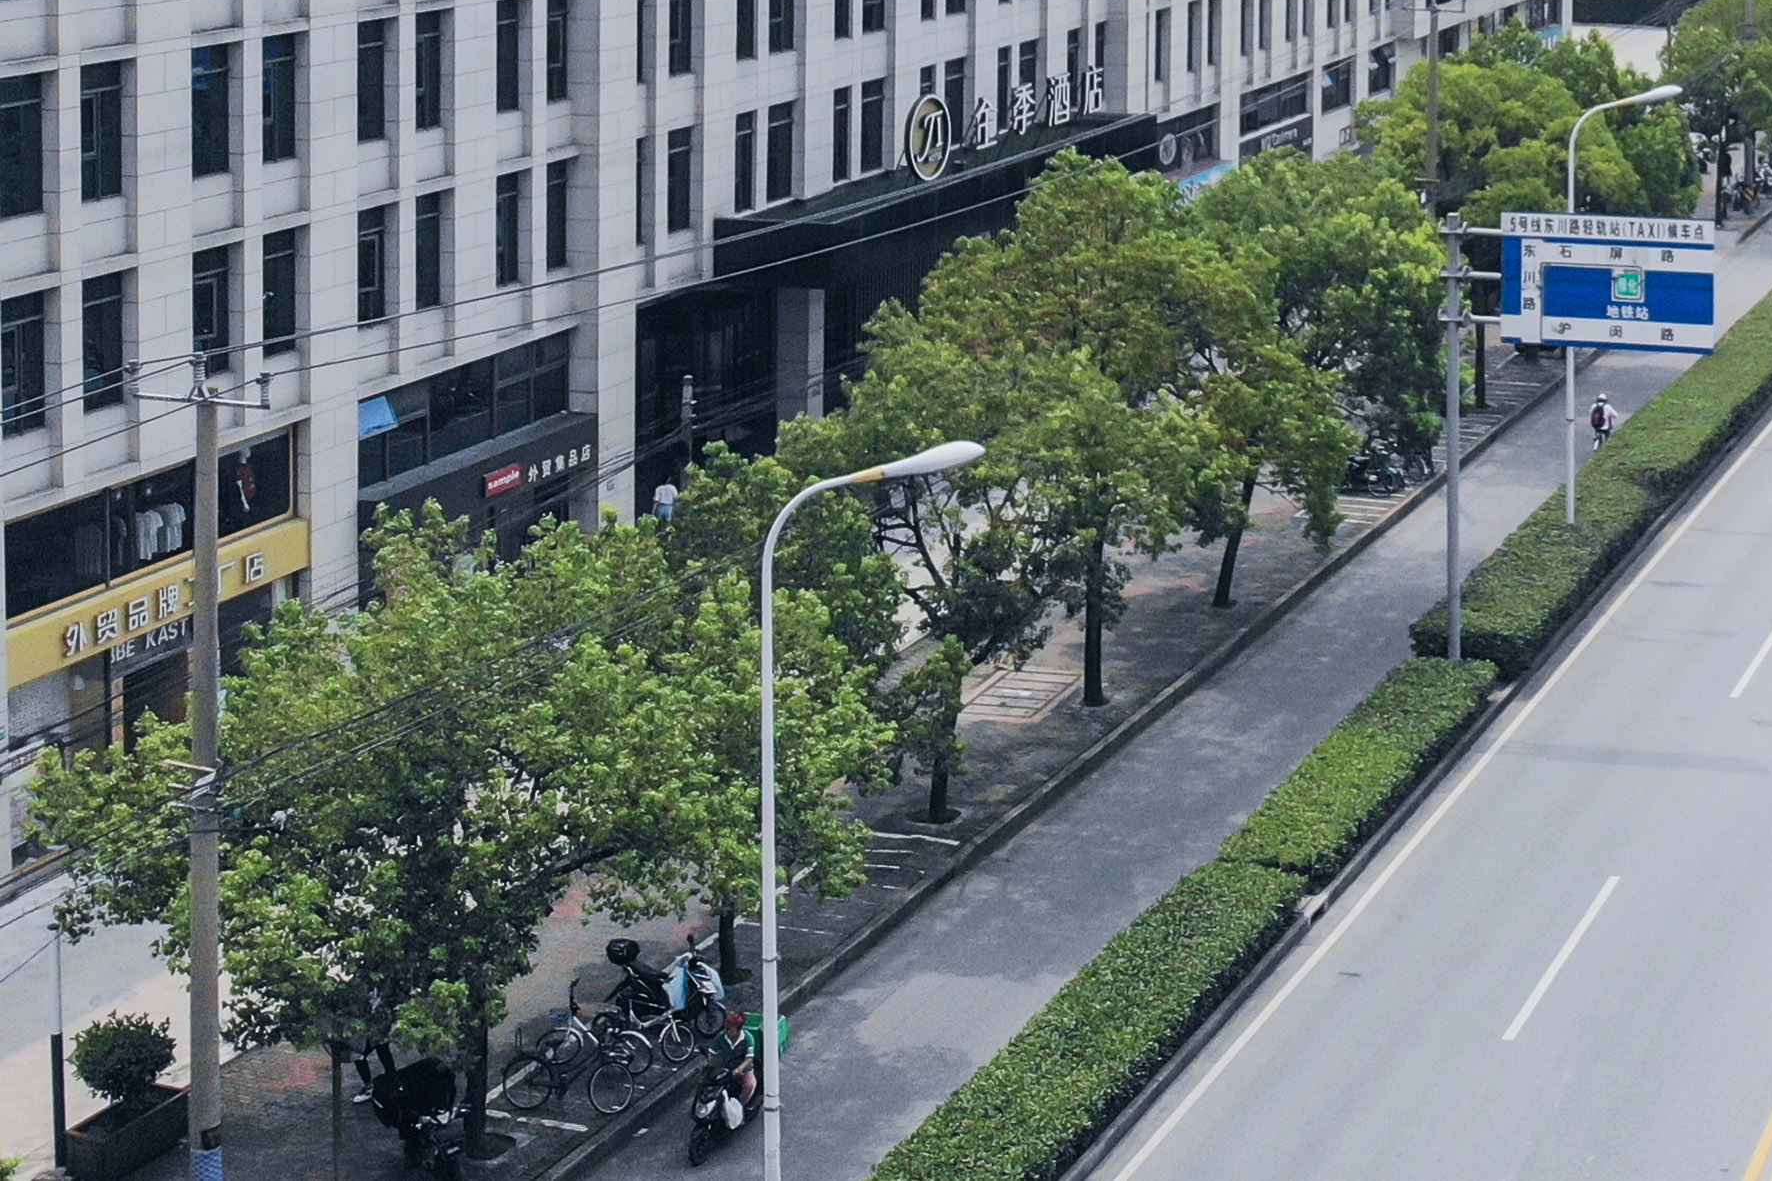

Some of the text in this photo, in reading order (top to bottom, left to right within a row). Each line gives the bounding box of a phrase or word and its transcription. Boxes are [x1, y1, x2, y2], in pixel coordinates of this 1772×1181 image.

[976, 67, 1104, 150] 全季酒店
[1559, 245, 1674, 263] 石屏路
[1523, 244, 1536, 310] 东川路
[1606, 305, 1649, 320] 地铁站
[1553, 322, 1674, 341] 沪闵路
[487, 470, 521, 491] sample
